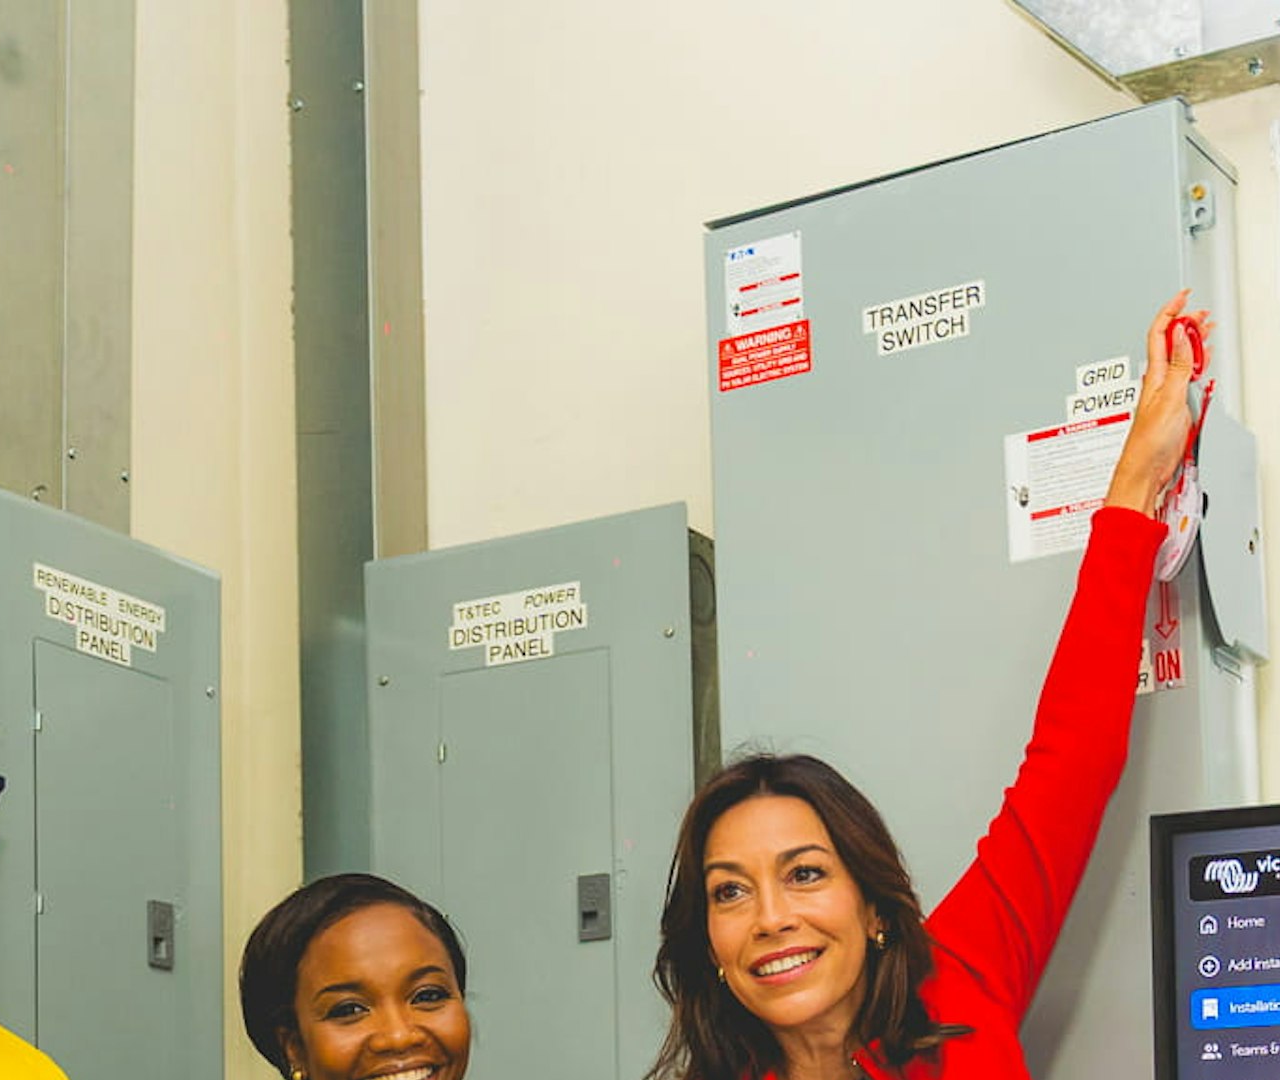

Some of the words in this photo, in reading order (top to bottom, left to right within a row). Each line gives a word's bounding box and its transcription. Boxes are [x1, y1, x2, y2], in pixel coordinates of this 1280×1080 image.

[866, 286, 981, 329] TRANSFER
[734, 327, 792, 351] WARNING
[883, 315, 965, 351] SWITCH
[1081, 363, 1125, 388] GRID
[1072, 387, 1136, 416] POWER
[37, 569, 108, 607] RENEWABLE
[118, 598, 162, 623] ENERGY
[458, 601, 501, 620] T&TEC
[524, 588, 576, 609] POWER
[48, 597, 154, 648] DISTRIBUTION
[453, 608, 583, 647] DISTRIBUTION
[80, 631, 128, 662] PANEL
[489, 638, 550, 662] PANEL
[1155, 648, 1181, 682] ON
[1227, 916, 1265, 930] Home
[1227, 958, 1252, 973] Add
[1230, 1043, 1268, 1057] Teams
[1270, 1041, 1280, 1055] &
